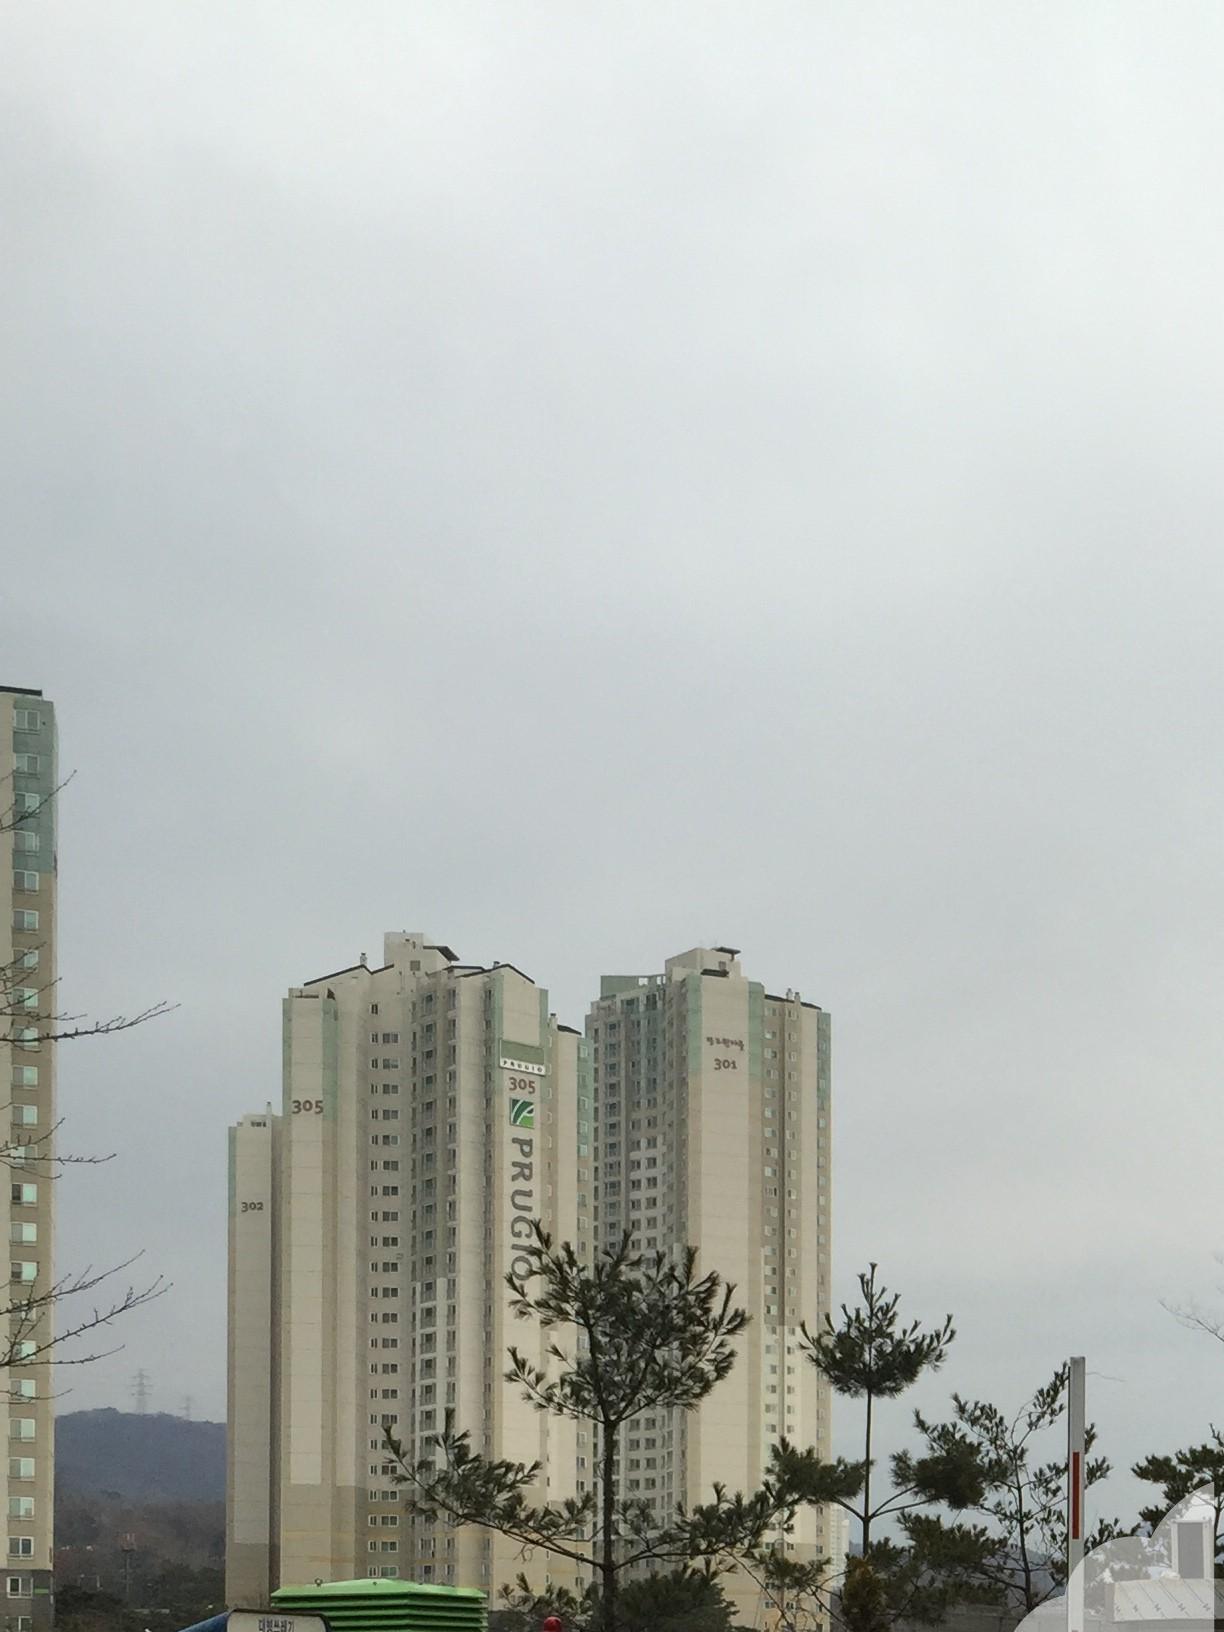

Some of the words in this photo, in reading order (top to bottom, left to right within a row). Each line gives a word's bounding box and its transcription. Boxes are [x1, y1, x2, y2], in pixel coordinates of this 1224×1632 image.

[713, 1058, 738, 1071] 301
[509, 1076, 536, 1095] 305
[292, 1099, 324, 1115] 305
[241, 1201, 264, 1213] 302
[510, 1137, 533, 1281] PRUGIO
